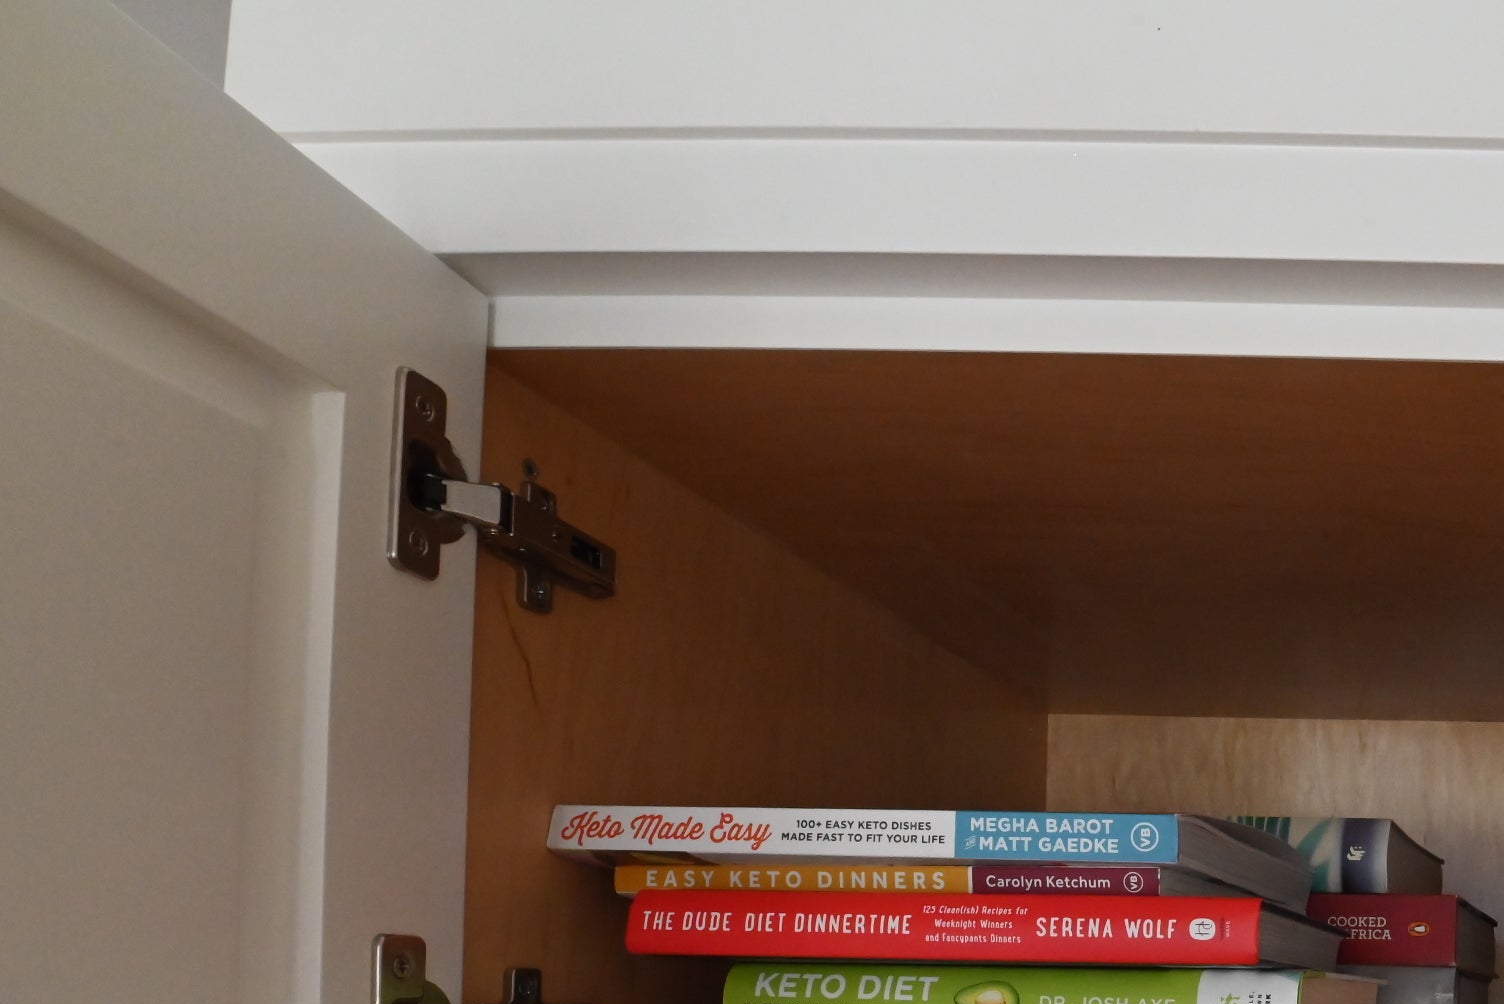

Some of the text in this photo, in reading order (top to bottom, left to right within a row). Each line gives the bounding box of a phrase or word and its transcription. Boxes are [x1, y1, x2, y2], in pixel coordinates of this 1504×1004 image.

[560, 811, 772, 851] Keto Made Easy
[796, 819, 932, 831] 100+ EASY KETO DISHES
[970, 817, 1114, 835] MEGHA BAROT
[781, 832, 946, 844] MADE FAST TO FIT YOUR LIFE
[979, 836, 1032, 852] MATT
[1038, 838, 1119, 854] GAEDKE
[1140, 828, 1151, 848] VB
[646, 870, 946, 890] EASY KETO DINNERS
[986, 875, 1111, 891] Carolyn Ketchum
[1130, 875, 1138, 890] VB
[923, 905, 1028, 917] 125 Clean(ish) Recipes for
[643, 910, 912, 935] THE DUDE DIET DINNERTIME
[934, 918, 1013, 929] Weeknight Winners
[1035, 917, 1177, 939] SERENA WOLF
[1327, 916, 1387, 928] COOKED
[925, 932, 1022, 944] and Fancypants Dinners
[1346, 929, 1392, 940] FRICA
[754, 972, 940, 1002] KETO DIET
